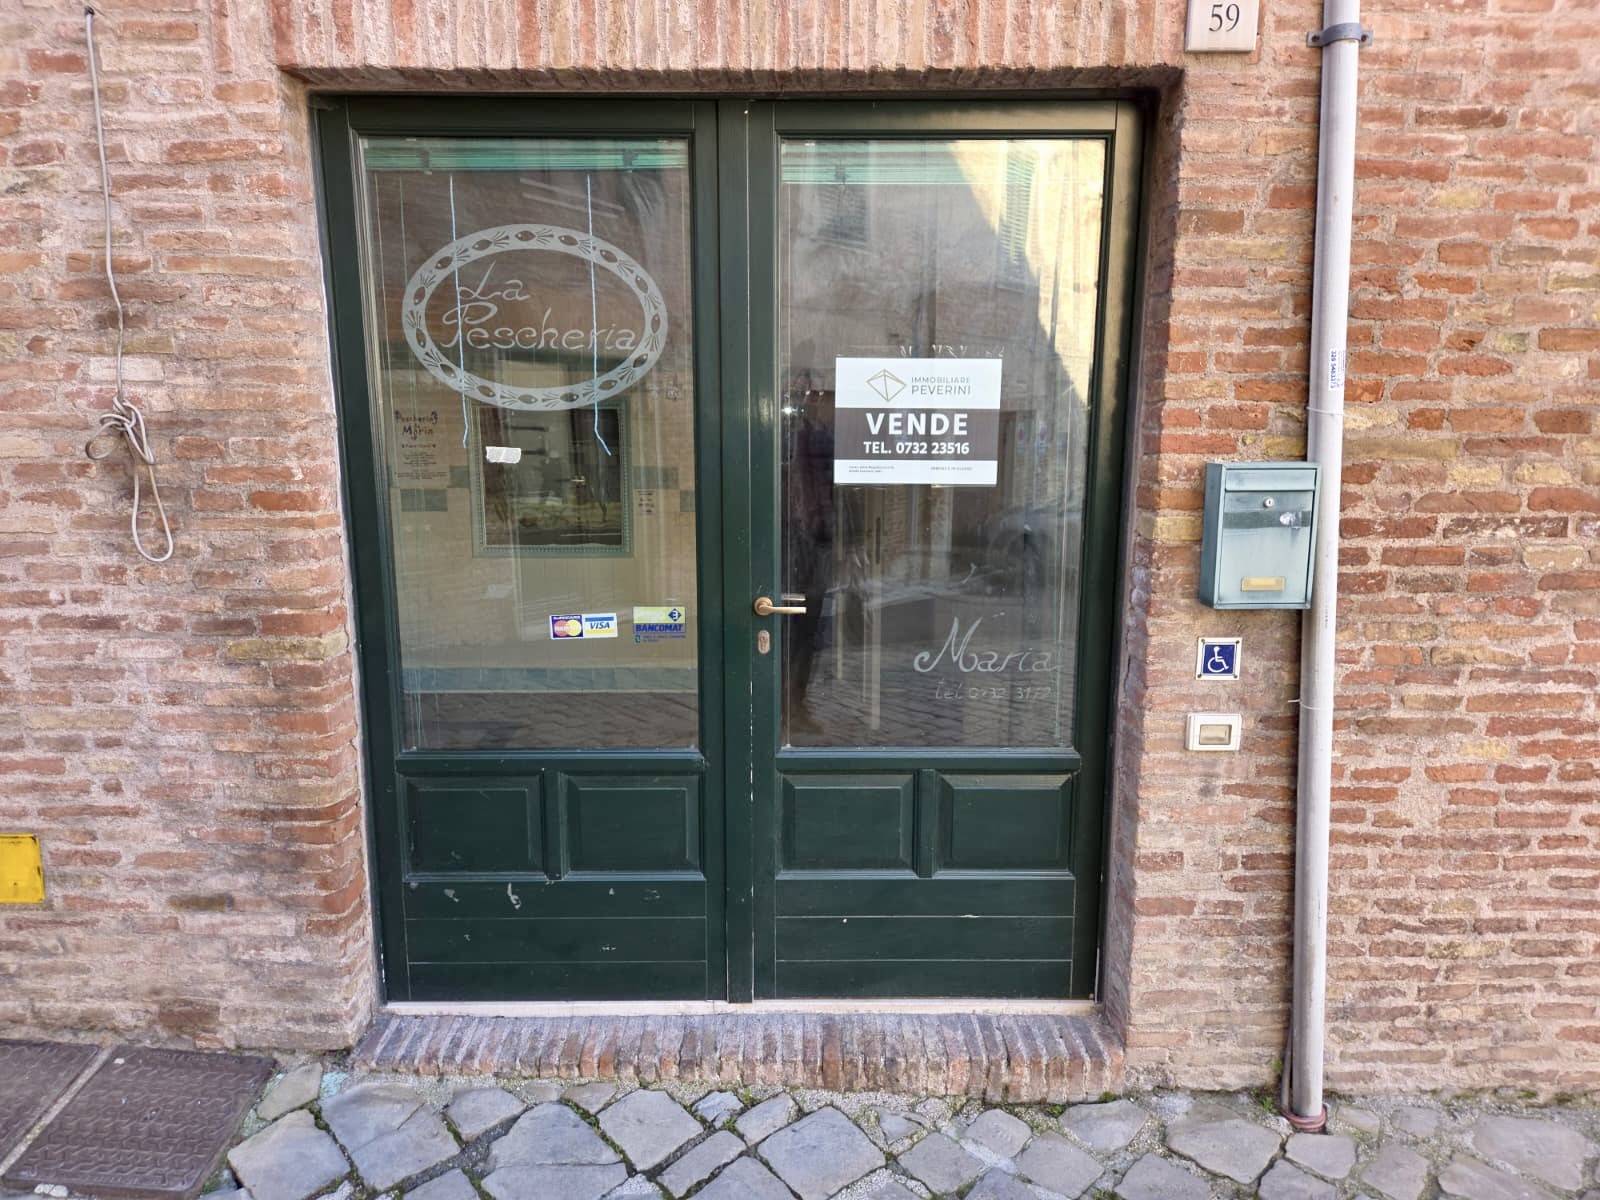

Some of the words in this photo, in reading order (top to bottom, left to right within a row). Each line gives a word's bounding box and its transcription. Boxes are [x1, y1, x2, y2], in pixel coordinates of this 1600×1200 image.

[1209, 3, 1240, 32] 59
[458, 259, 530, 301] La
[440, 301, 637, 350] Pescheria
[911, 376, 970, 384] IMMOBILIARE
[911, 385, 971, 395] PEVERINI
[865, 413, 968, 436] VENDE
[864, 441, 892, 454] TEL.
[896, 442, 928, 454] 0732
[931, 442, 970, 455] 23516
[589, 621, 610, 630] VISA
[635, 624, 682, 632] BANCOMAT
[913, 616, 1060, 672] Maria
